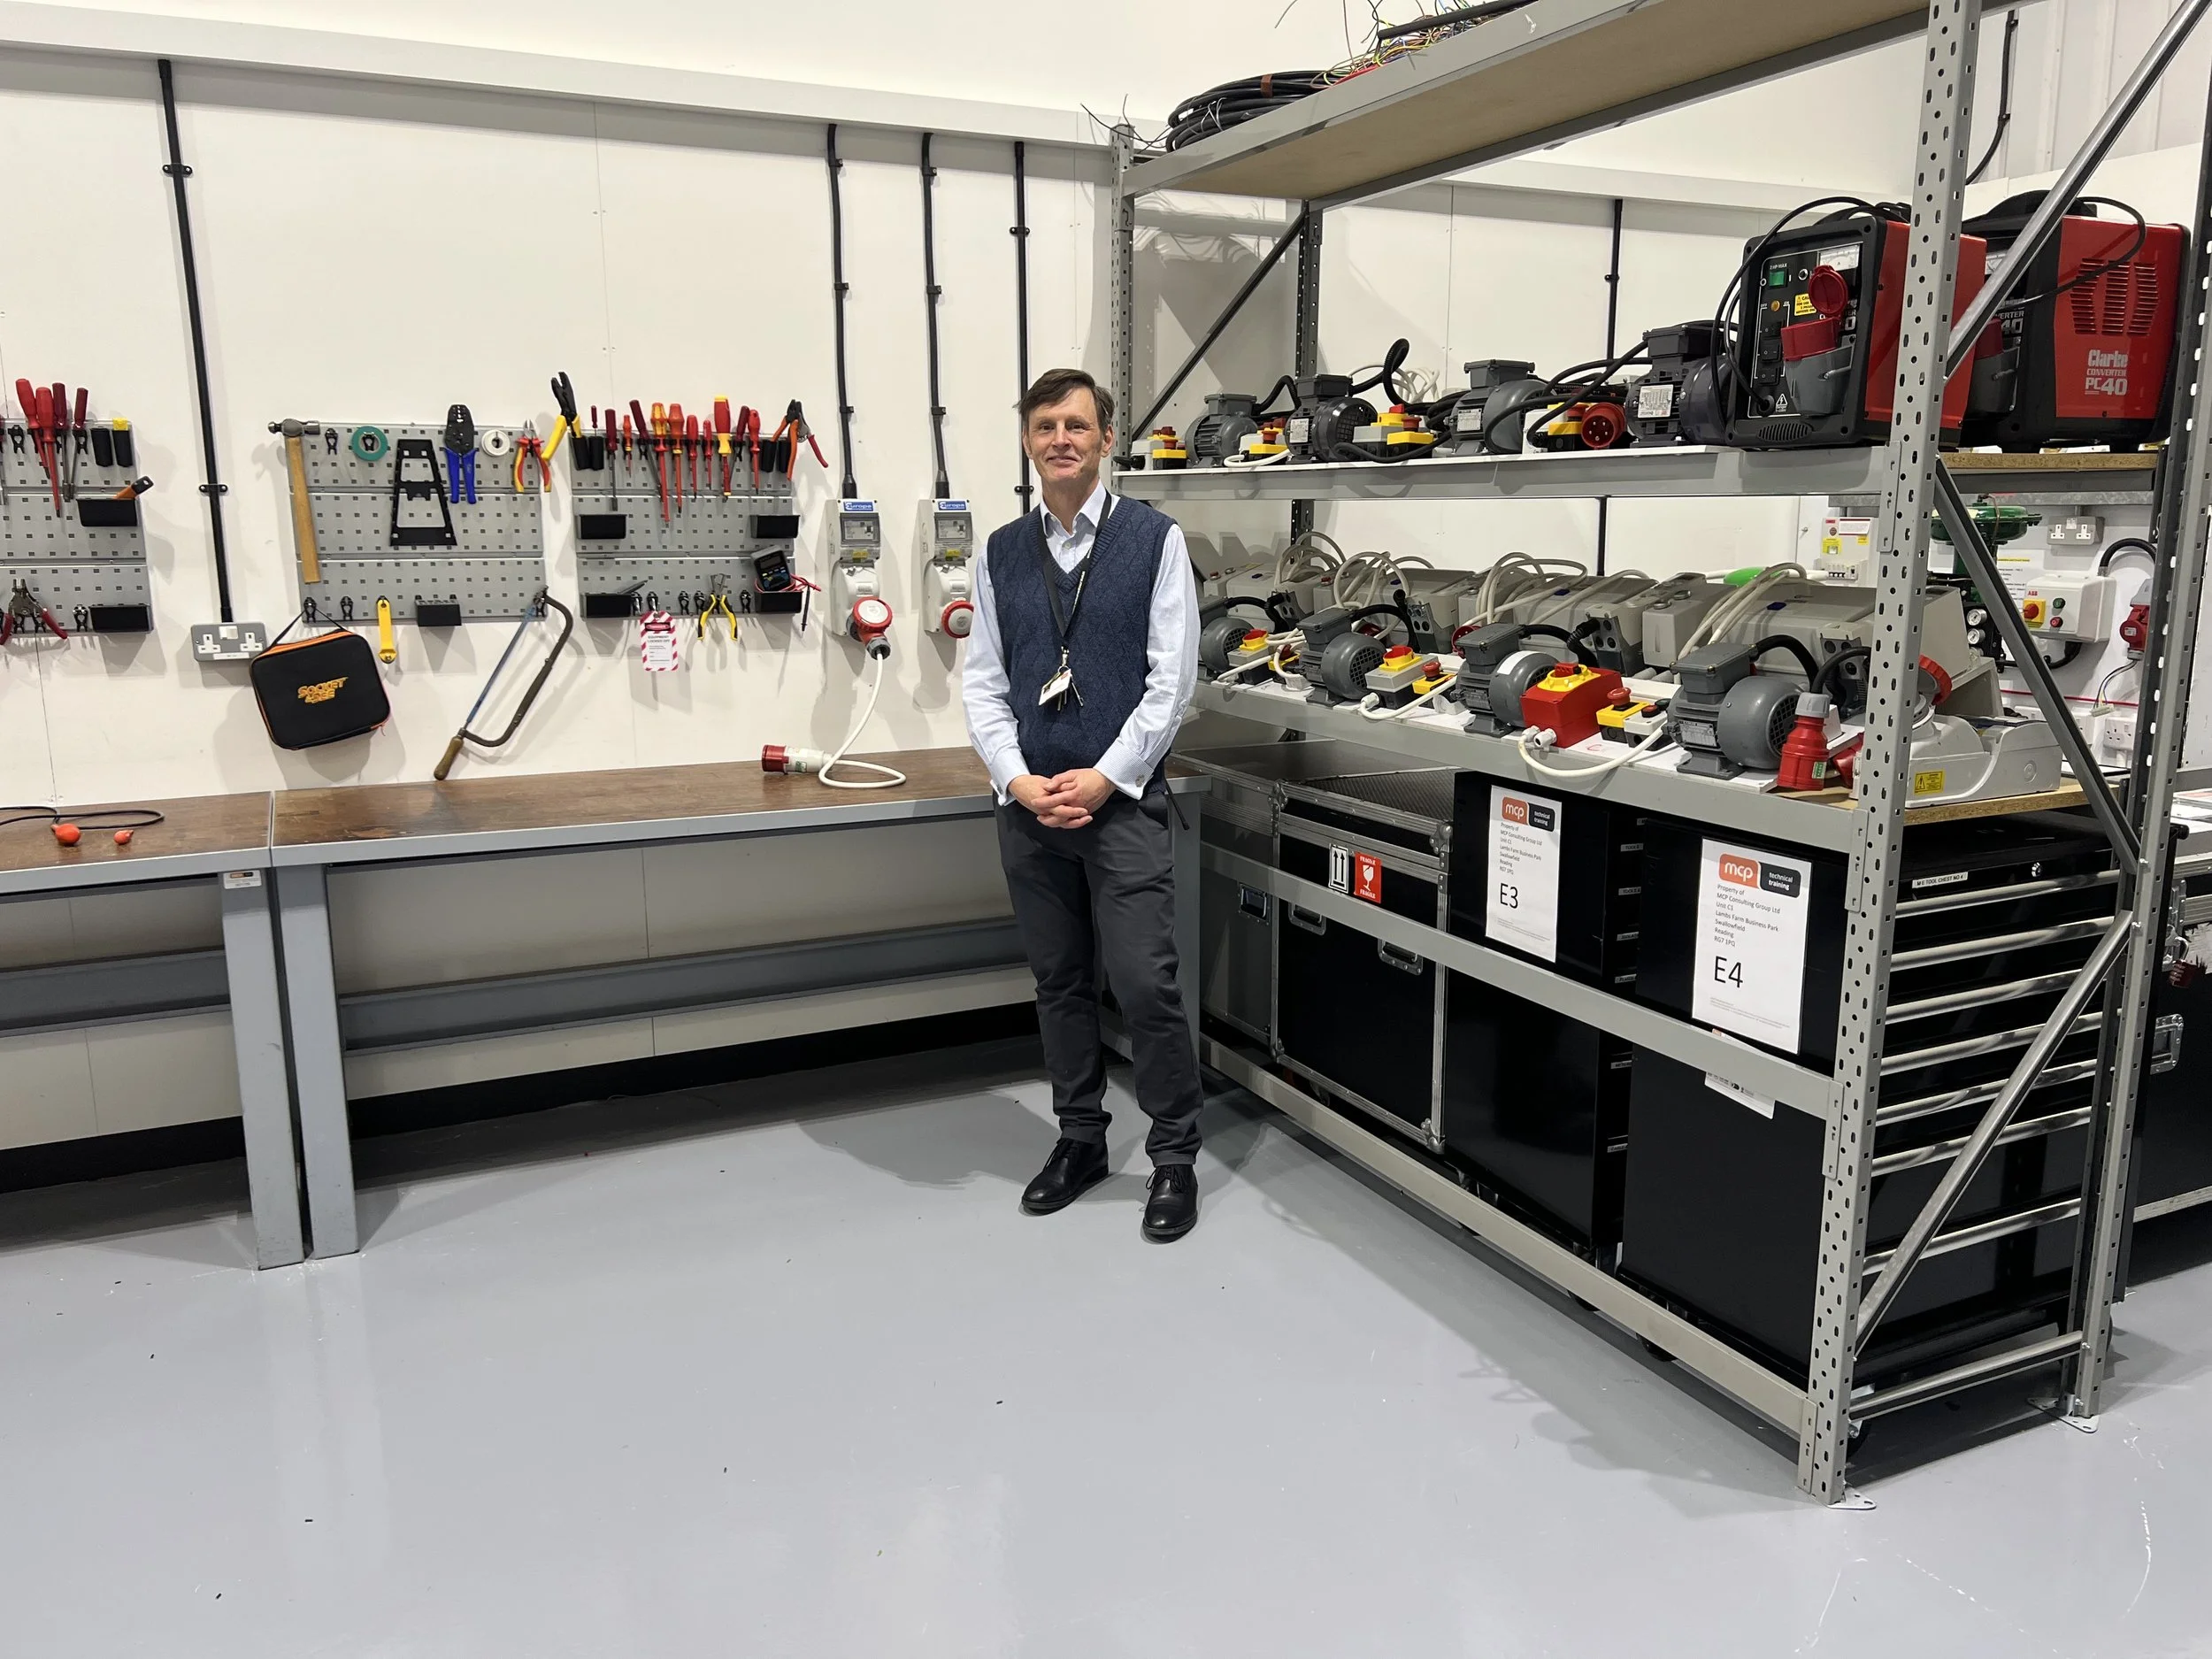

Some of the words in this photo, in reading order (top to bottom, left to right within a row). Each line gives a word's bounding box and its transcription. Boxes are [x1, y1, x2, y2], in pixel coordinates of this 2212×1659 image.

[2088, 349, 2129, 368] Clarke
[2085, 377, 2128, 396] PC40
[297, 677, 349, 699] SOCKET
[1505, 803, 1525, 820] mcp
[1533, 810, 1551, 819] technical
[1501, 822, 1514, 831] Property
[1533, 818, 1548, 826] training
[1509, 832, 1525, 841] Consulting
[1519, 849, 1533, 858] Business
[1359, 856, 1376, 865] FRAGILE
[1724, 862, 1754, 882] mcp
[1769, 872, 1793, 883] technical
[1717, 884, 1738, 895] Property
[1768, 879, 1790, 891] training
[1359, 888, 1376, 899] FRAGILE
[1500, 882, 1518, 909] E3
[1728, 895, 1755, 909] Consulting
[1755, 902, 1771, 912] Group
[1715, 918, 1746, 932] Swallowfield
[1745, 918, 1767, 928] Business
[1767, 923, 1778, 932] Park
[1715, 927, 1734, 939] Reading
[1725, 939, 1736, 948] 1PQ
[1714, 955, 1743, 988] E4
